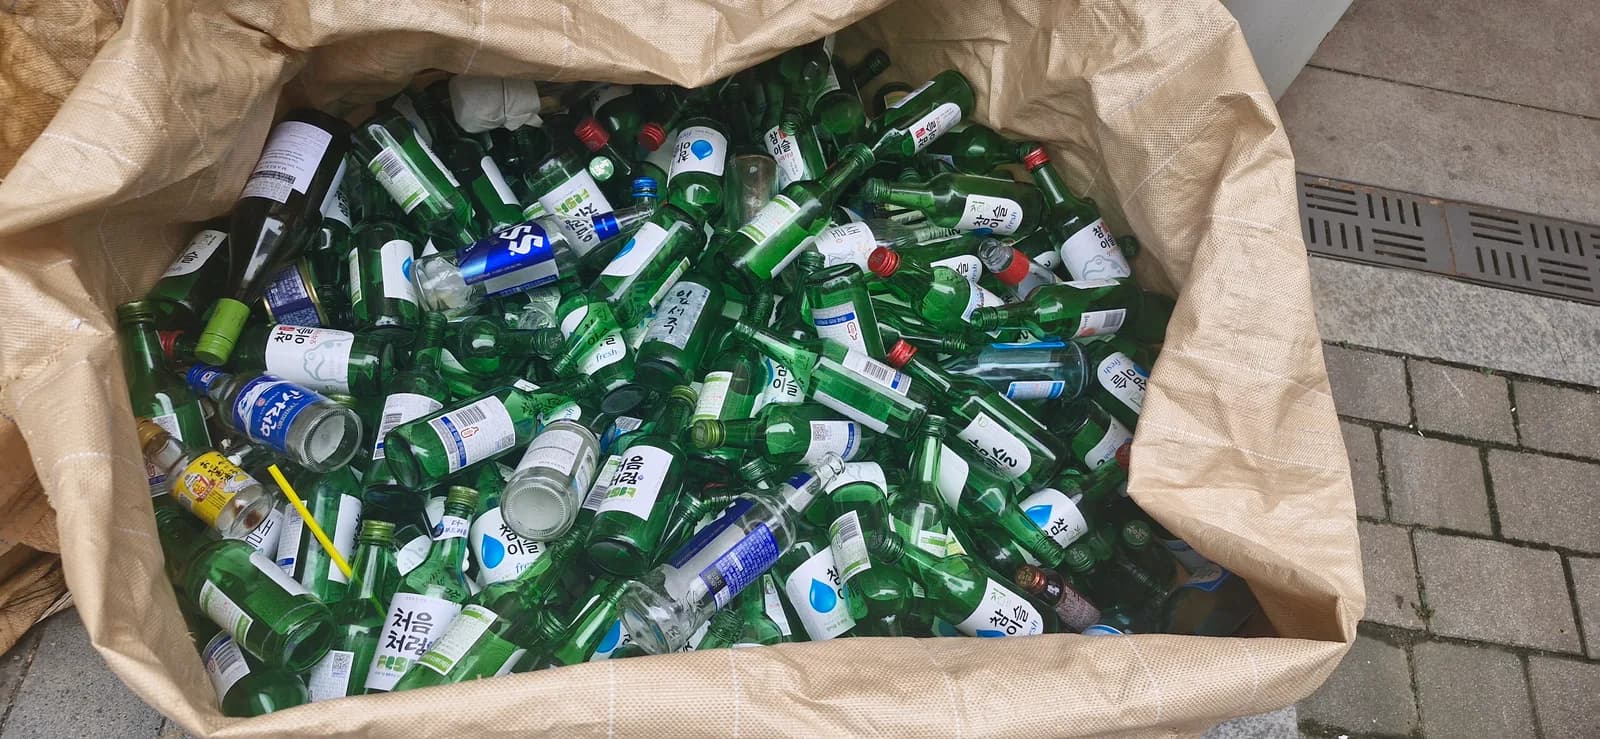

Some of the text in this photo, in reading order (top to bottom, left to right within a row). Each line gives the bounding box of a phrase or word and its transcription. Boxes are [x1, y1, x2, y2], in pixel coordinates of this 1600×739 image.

[595, 348, 619, 364] fresh
[1103, 357, 1122, 375] fresh
[772, 377, 798, 397] 이슬
[392, 608, 434, 635] 처음
[989, 608, 1010, 628] 참
[386, 630, 431, 656] 처럼
